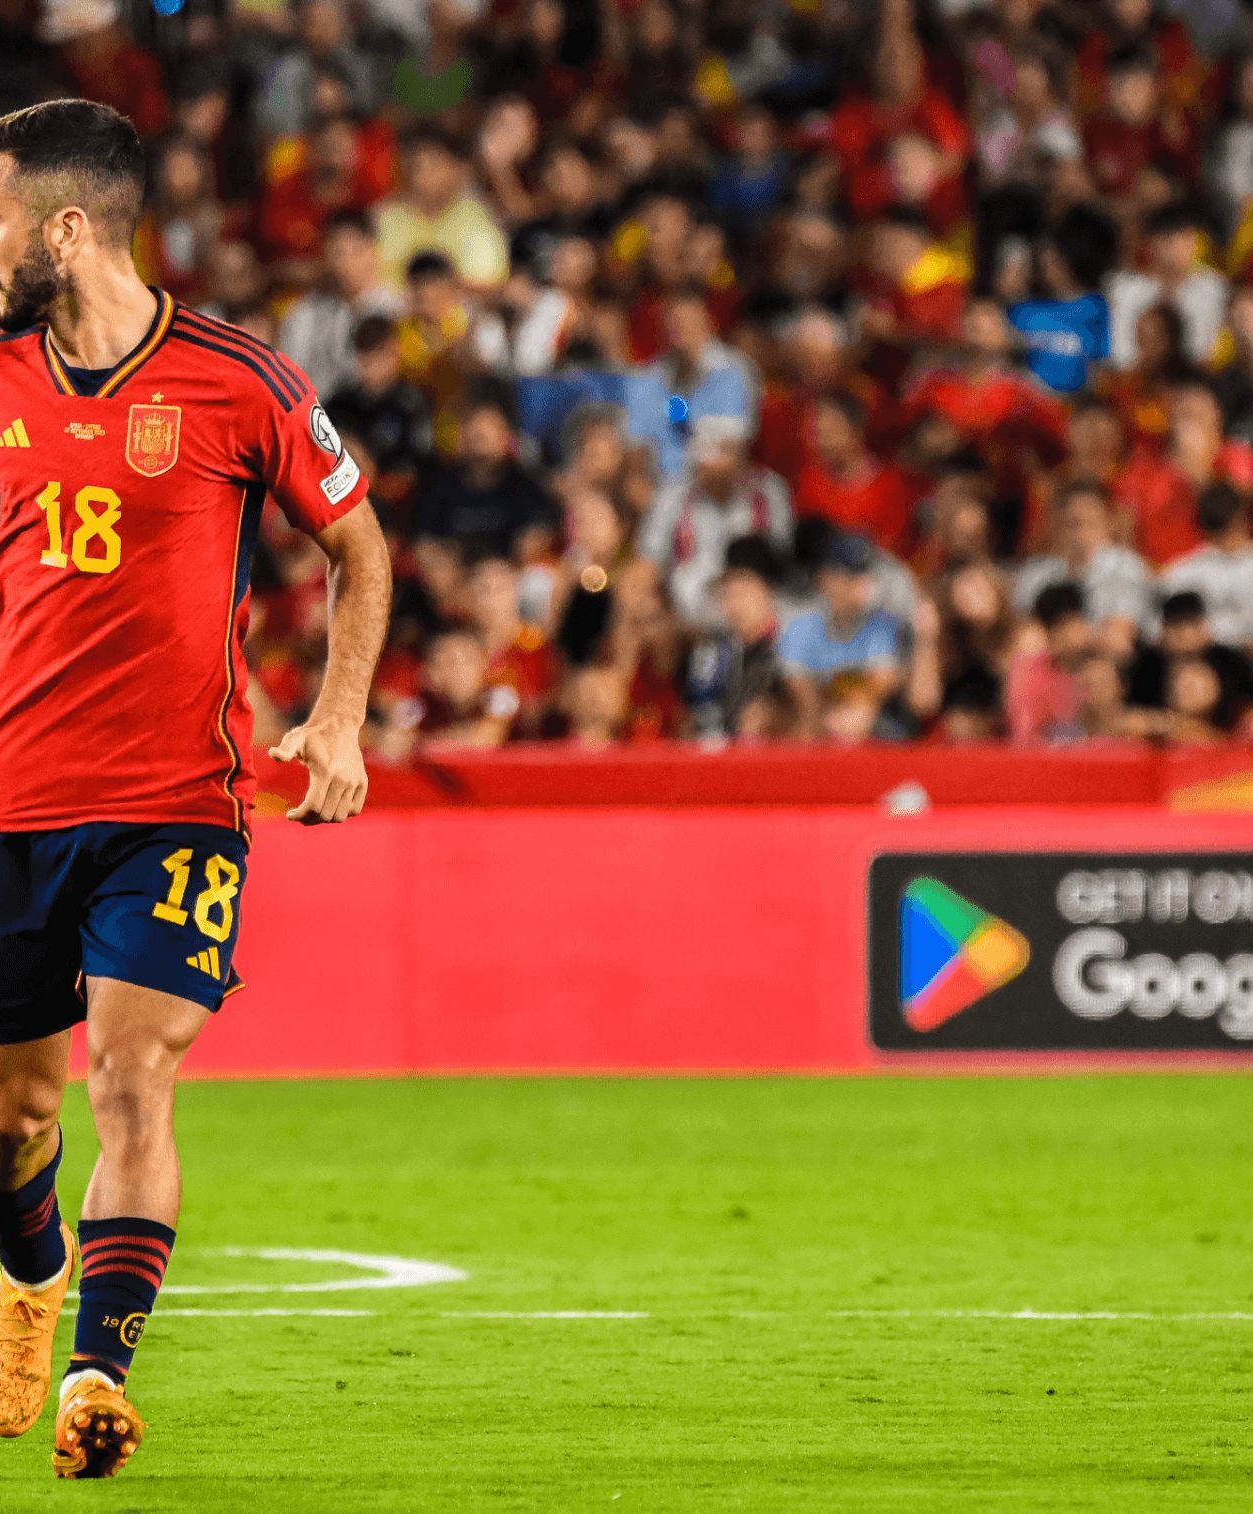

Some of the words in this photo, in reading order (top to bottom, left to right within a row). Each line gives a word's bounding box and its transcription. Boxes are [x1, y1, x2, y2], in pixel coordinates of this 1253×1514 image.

[35, 481, 122, 574] 18
[152, 848, 240, 943] 18
[1056, 867, 1146, 924] GET
[1147, 867, 1193, 924] IT
